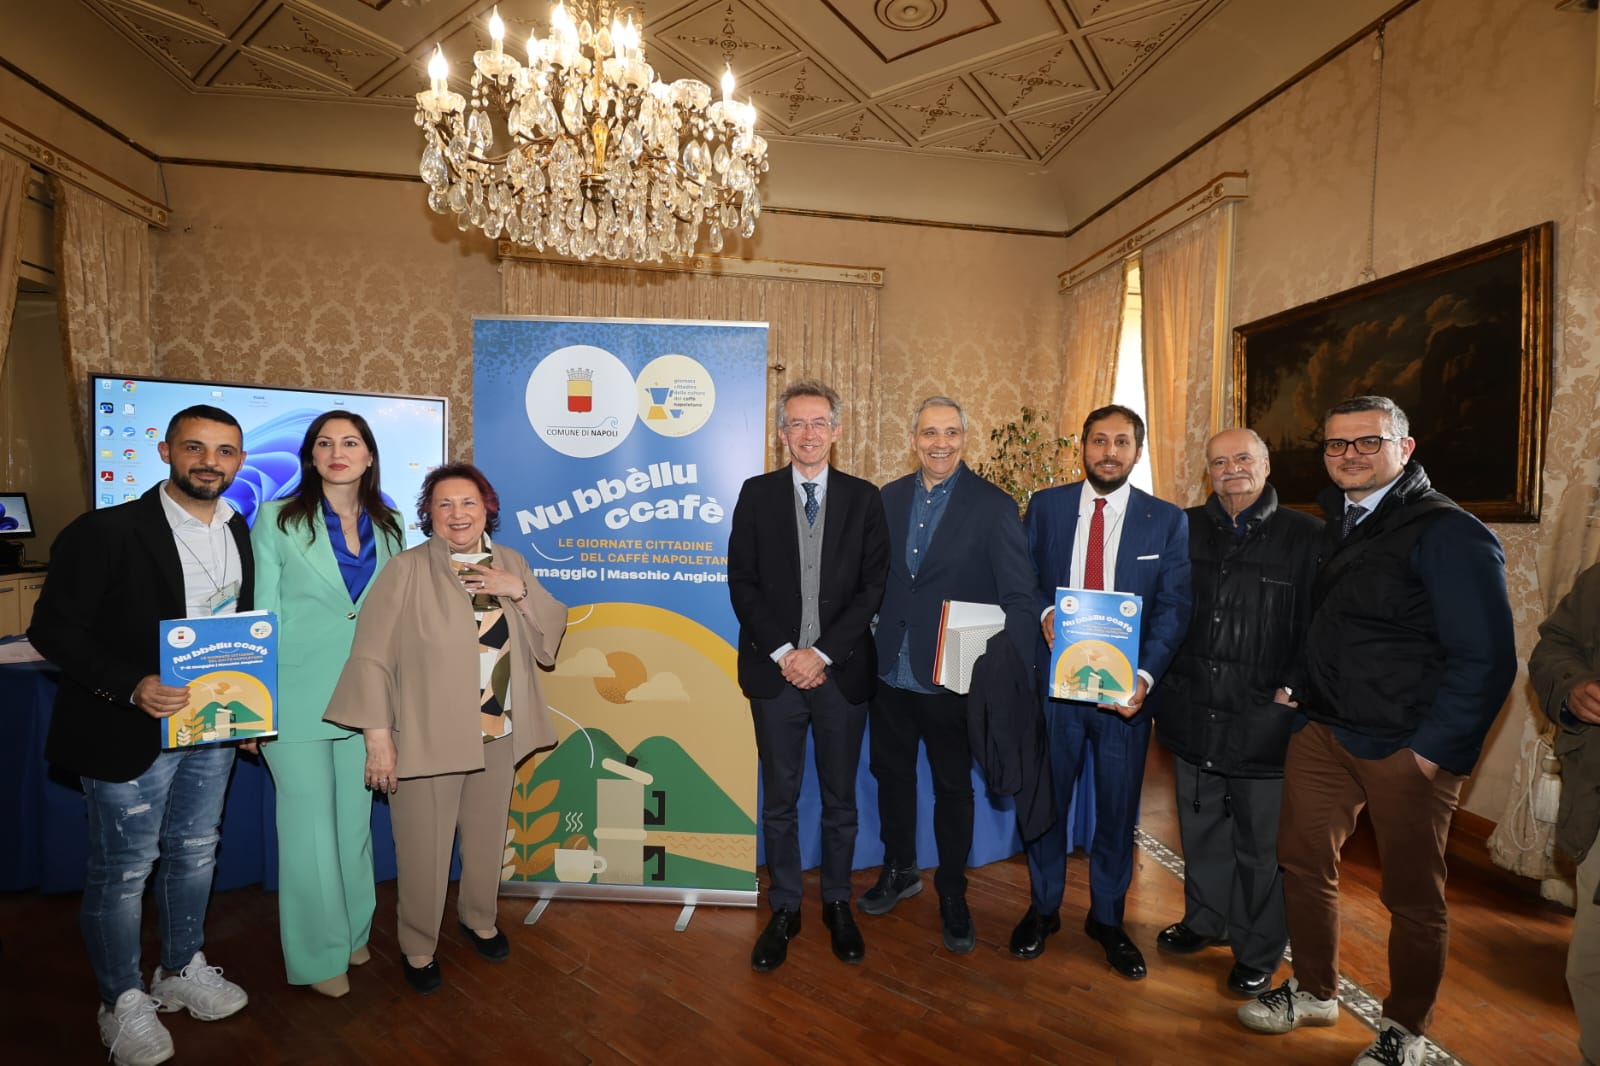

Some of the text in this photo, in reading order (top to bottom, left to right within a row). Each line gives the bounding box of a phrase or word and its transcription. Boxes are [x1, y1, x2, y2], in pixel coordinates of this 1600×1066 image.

[546, 429, 618, 437] COMUNE DI NAPOLI
[516, 462, 698, 535] Nu bbèllu
[604, 494, 724, 529] ccafè
[558, 538, 713, 552] LE GIORNATE CITTADINE
[580, 552, 728, 566] DEL CAFFÈ NAPOLETAN
[533, 567, 597, 580] maggio
[607, 569, 670, 581] Maschio
[673, 571, 729, 583] Angioin
